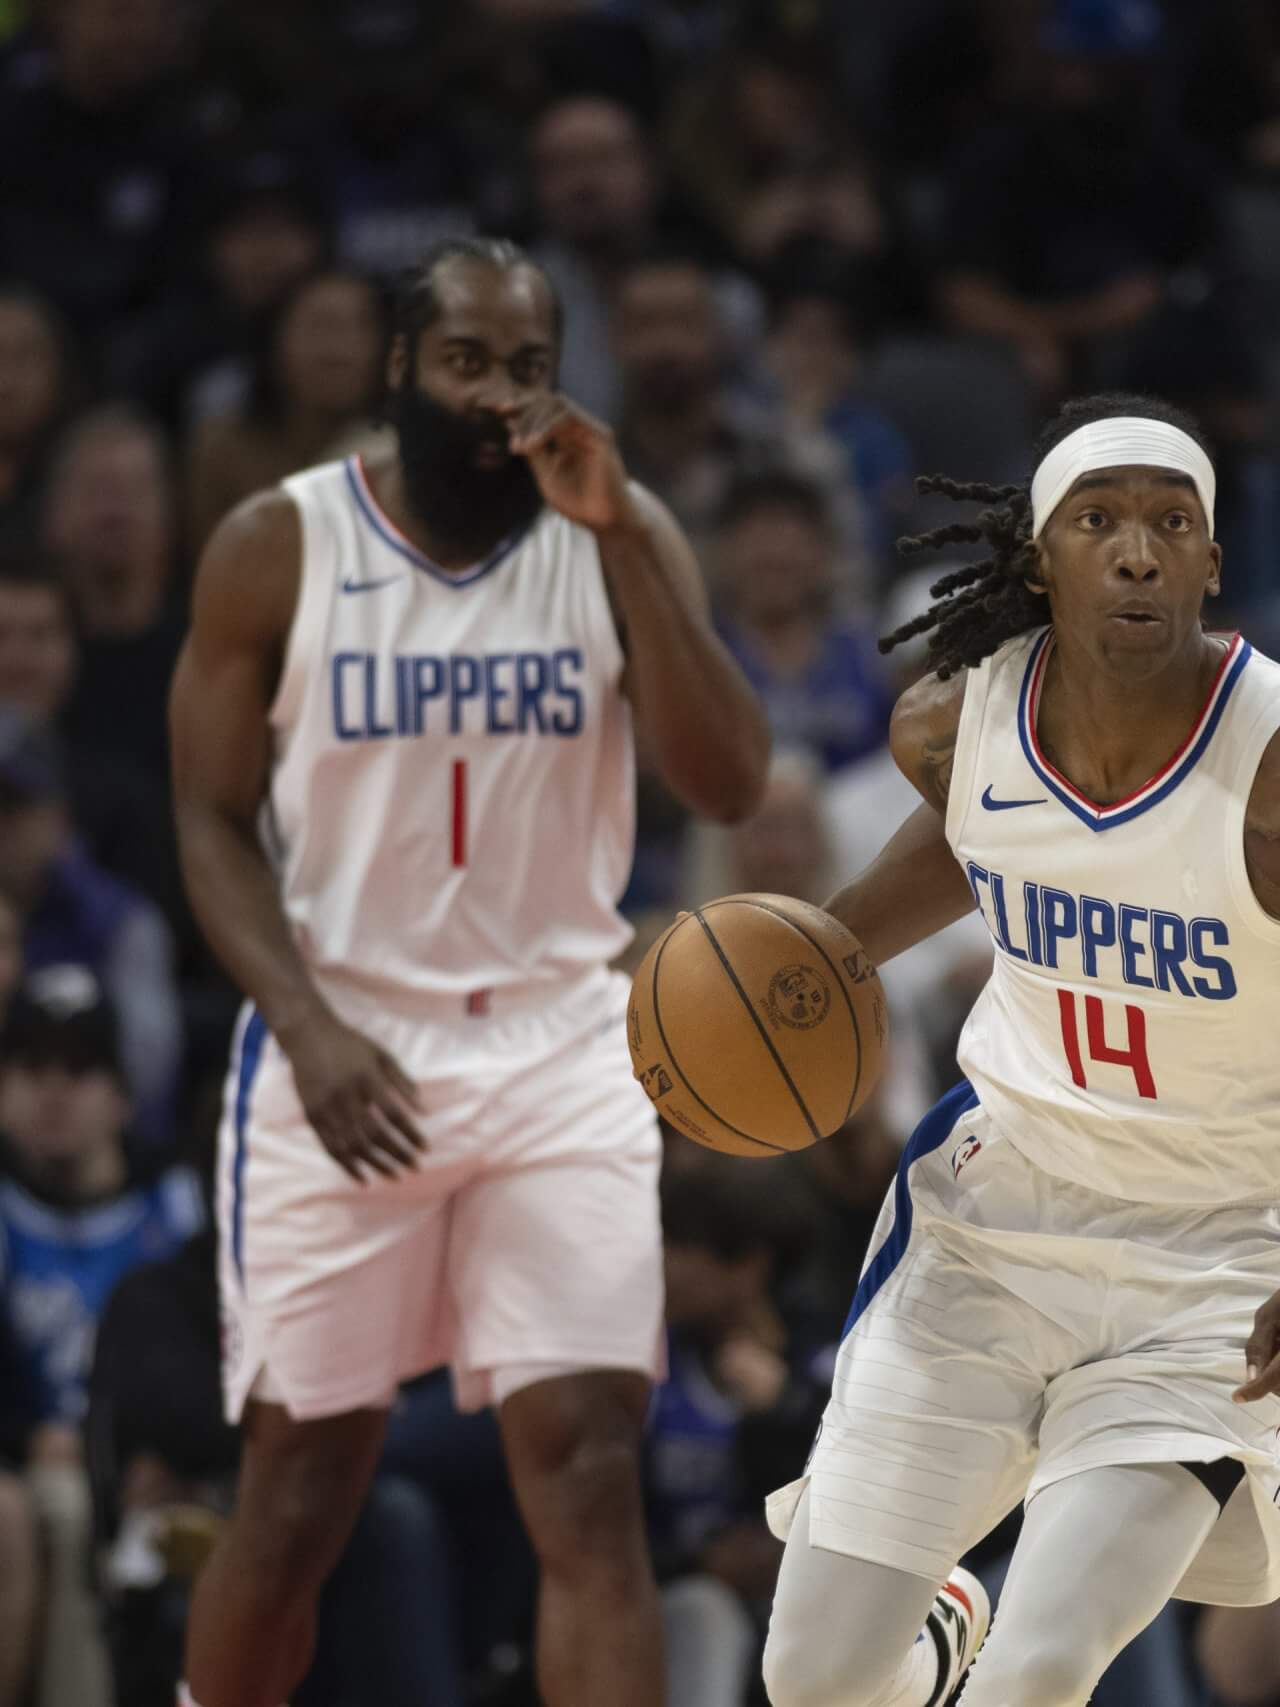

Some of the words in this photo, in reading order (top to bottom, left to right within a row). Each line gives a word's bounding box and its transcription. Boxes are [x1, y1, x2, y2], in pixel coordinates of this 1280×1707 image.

[331, 648, 586, 741] CLIPPERS
[452, 757, 469, 869] 1
[966, 860, 1238, 1001] CLIPPERS
[1056, 988, 1158, 1100] 14
